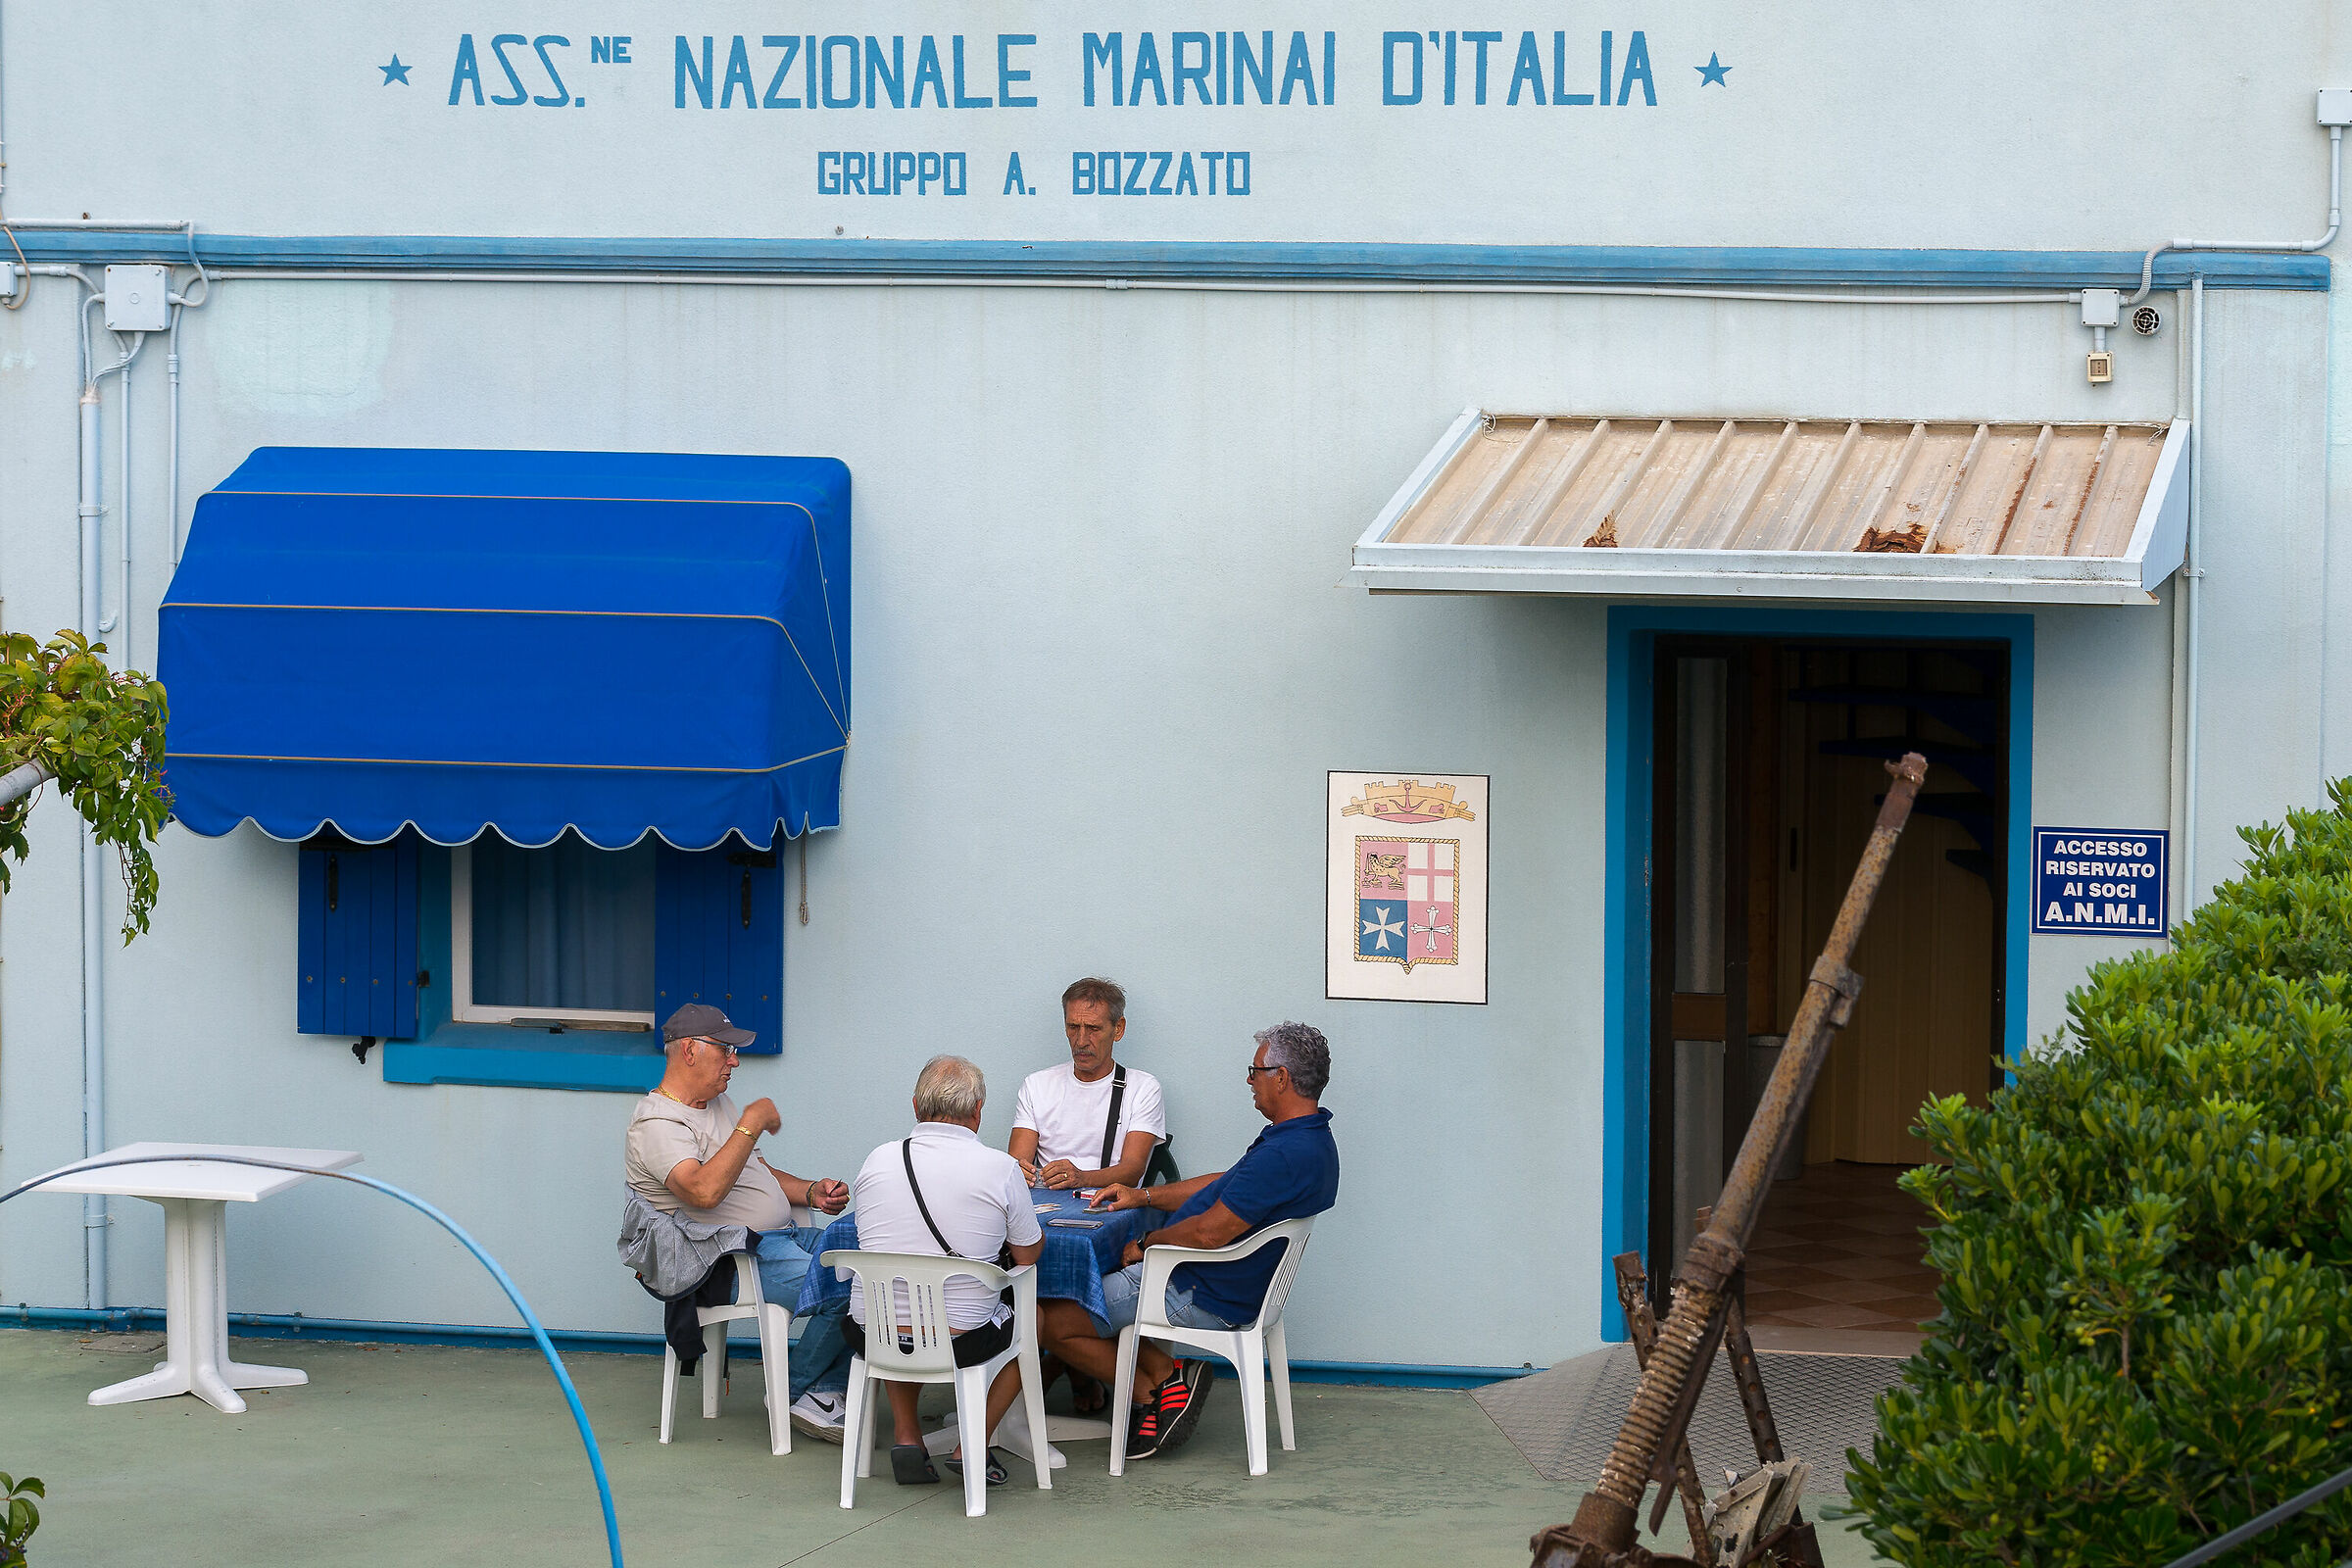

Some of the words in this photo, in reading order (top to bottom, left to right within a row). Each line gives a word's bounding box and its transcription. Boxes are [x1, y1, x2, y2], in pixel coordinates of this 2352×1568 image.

[675, 34, 1038, 109] NAZIONALE
[1083, 31, 1336, 107] MARINAI
[1383, 31, 1657, 107] D'ITALIA
[817, 151, 967, 197] GRUPPO
[1003, 151, 1036, 196] A.
[1072, 151, 1250, 197] BOZZATO
[2053, 840, 2148, 858] ACCESSO
[2045, 860, 2156, 878] RISERVATO
[2063, 882, 2082, 897] AI
[2088, 883, 2136, 899] SOCI
[2044, 901, 2156, 925] A.N.M.I.
